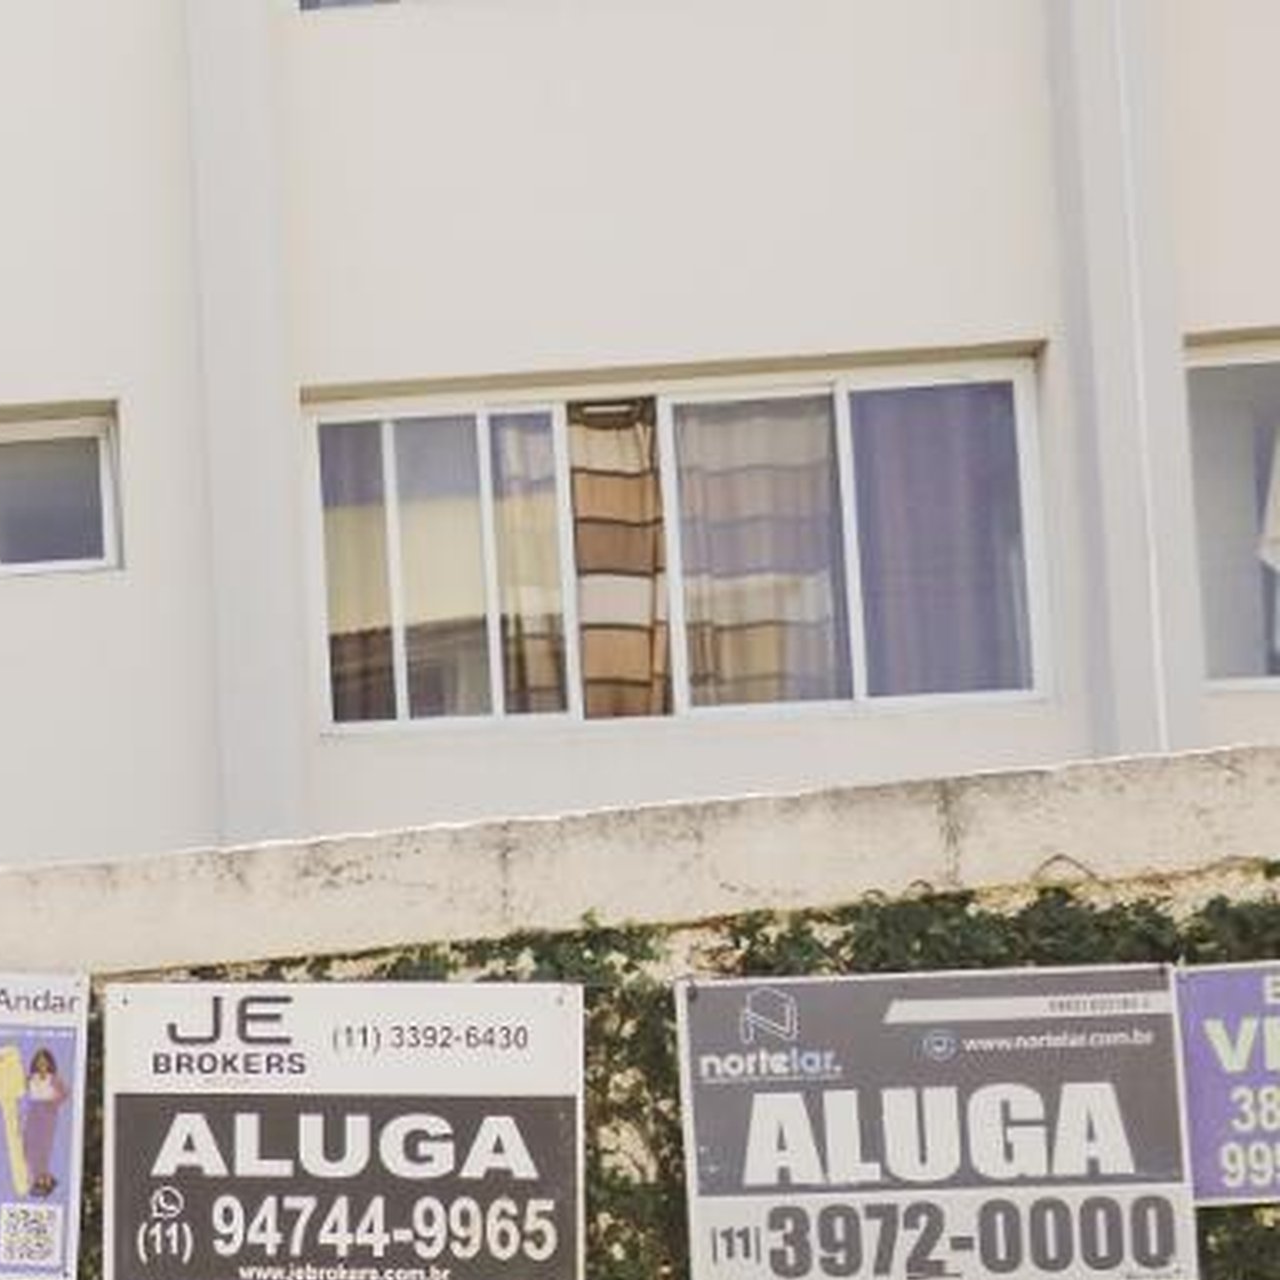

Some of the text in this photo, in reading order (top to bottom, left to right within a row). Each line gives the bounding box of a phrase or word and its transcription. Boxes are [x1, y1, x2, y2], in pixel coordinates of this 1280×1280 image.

[167, 996, 293, 1045] JE
[332, 1025, 529, 1052] (11) 3392-6430
[152, 1053, 307, 1075] BROKERS
[151, 1112, 539, 1179] ALUGA
[743, 1081, 1136, 1187] ALUGA
[138, 1195, 558, 1263] (11) 94744-9965
[768, 1197, 1176, 1279] 3972-0000
